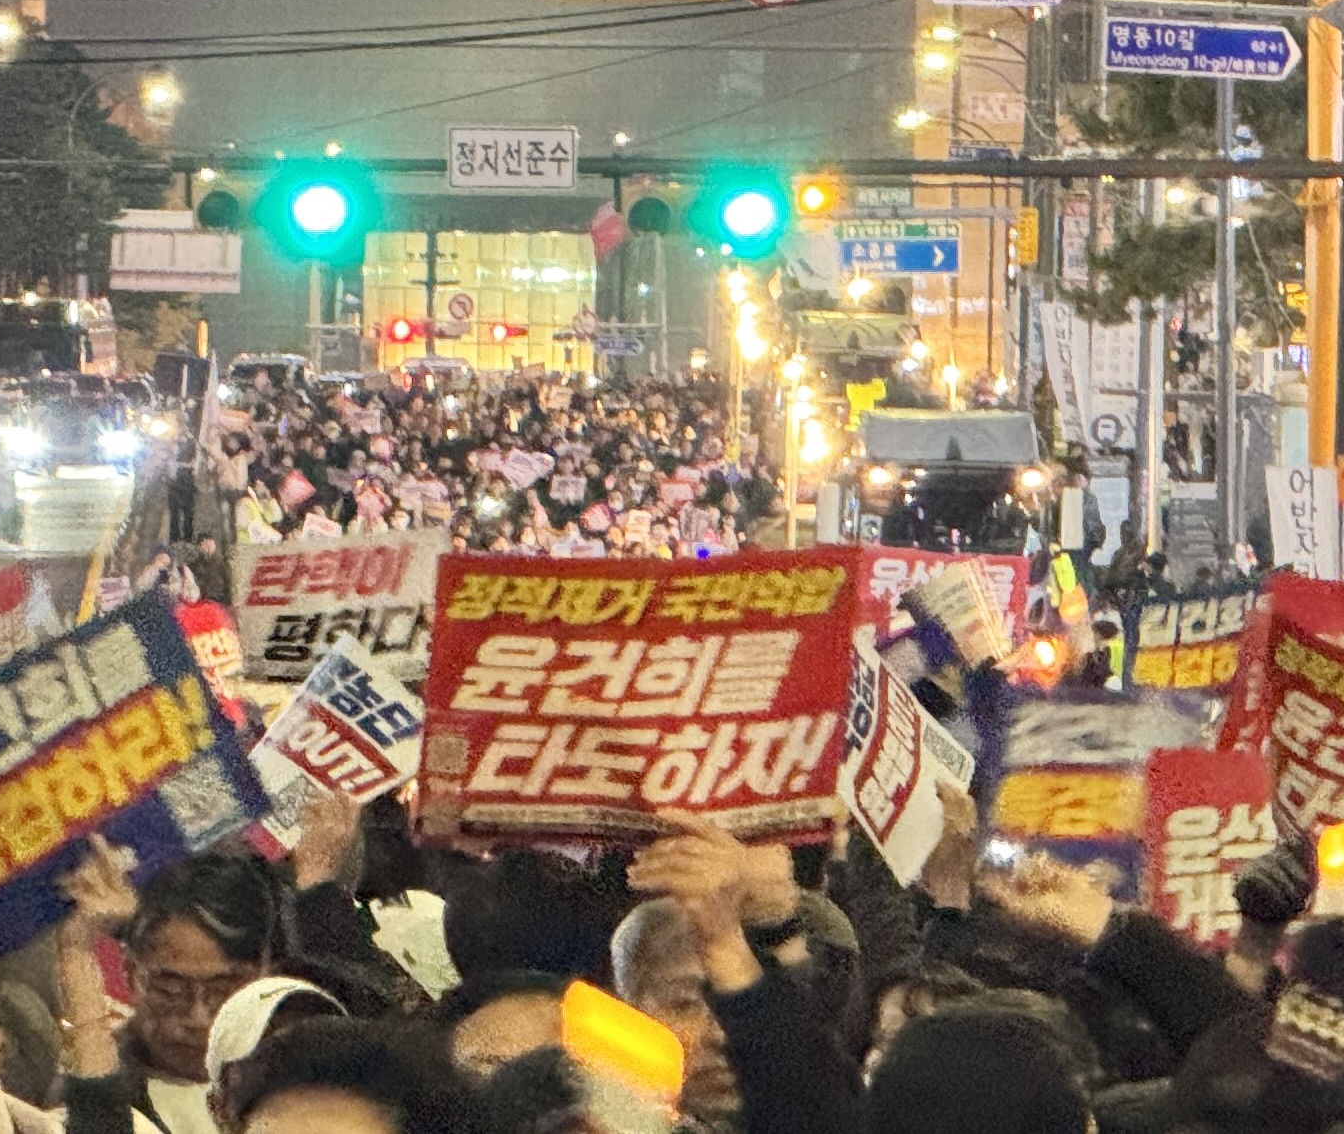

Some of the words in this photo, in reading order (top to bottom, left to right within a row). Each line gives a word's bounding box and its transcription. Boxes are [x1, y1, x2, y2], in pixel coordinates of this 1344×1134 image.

[1112, 24, 1196, 52] 명동10길
[455, 140, 571, 177] 정지선준수
[447, 572, 657, 626] 정적제거
[449, 629, 801, 718] 윤건희를
[286, 719, 385, 793] OUT!
[466, 711, 840, 806] 타도하자!
